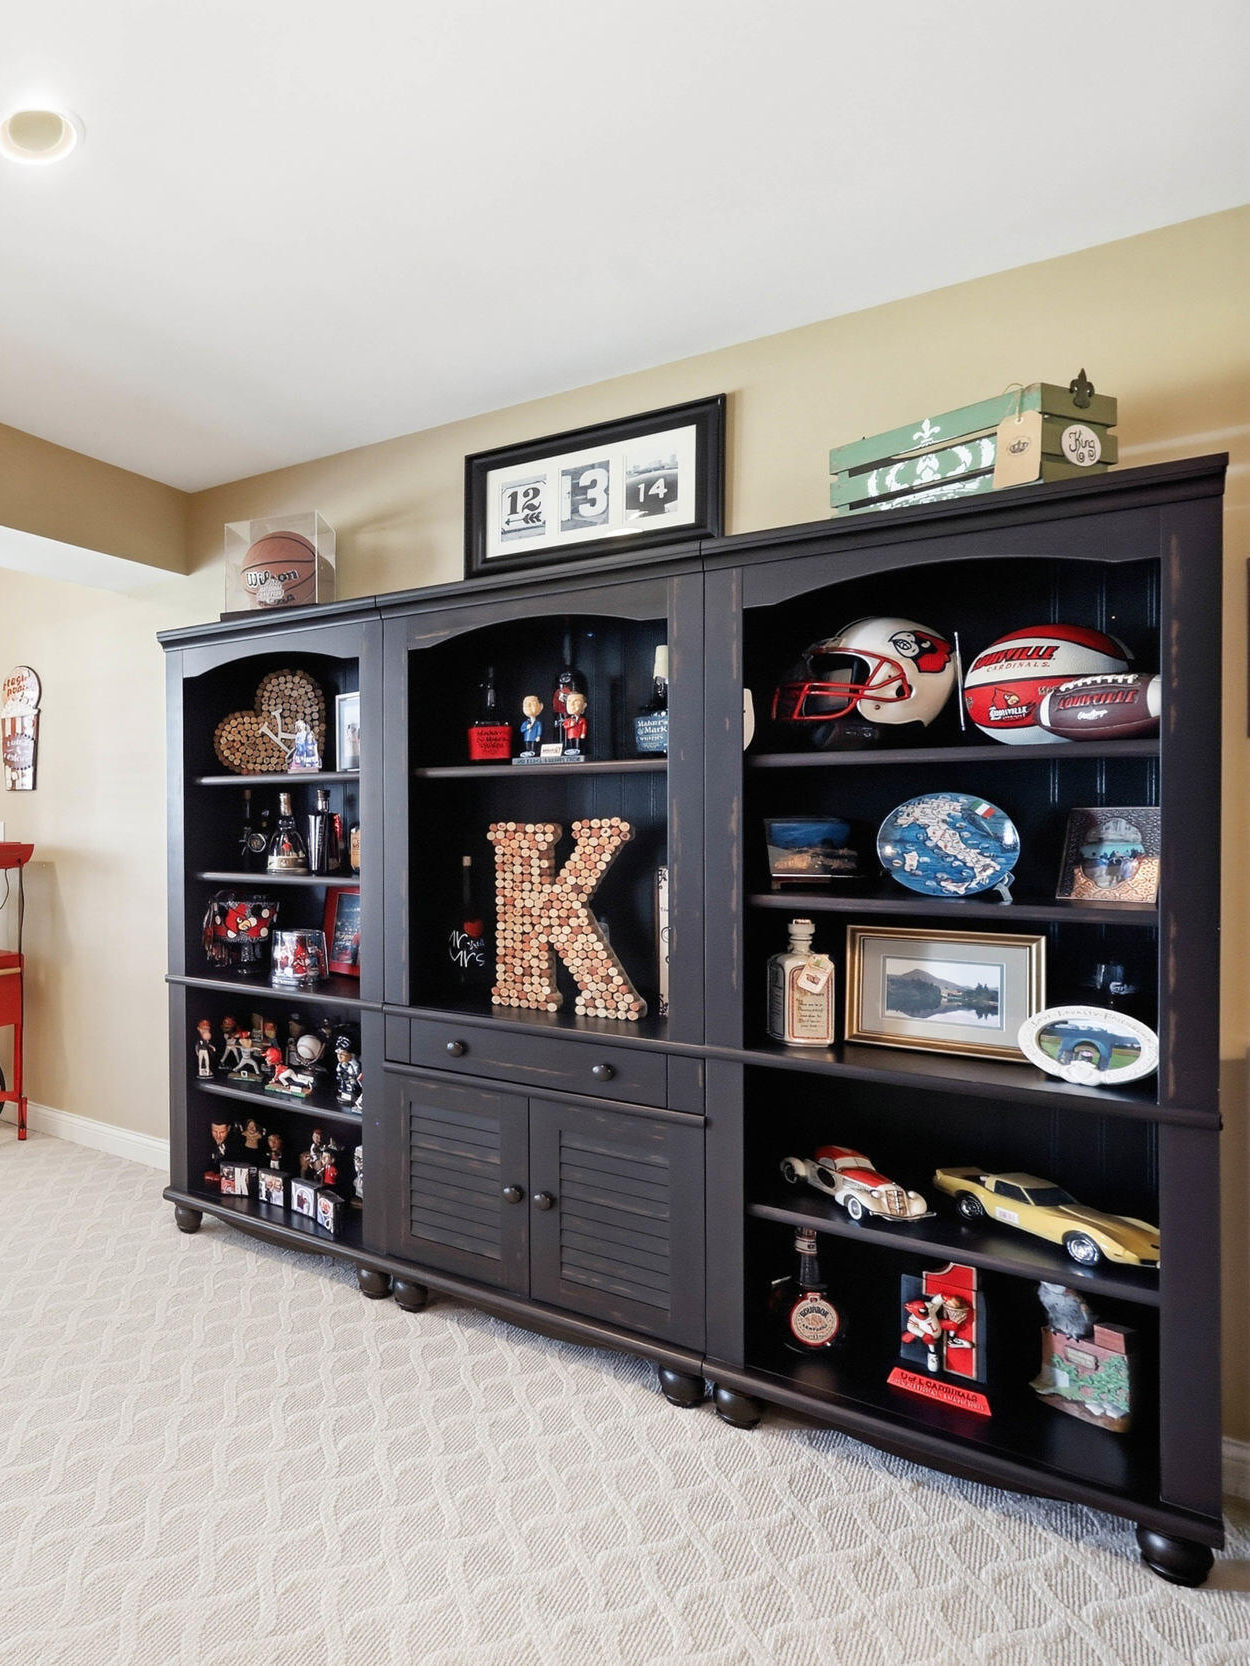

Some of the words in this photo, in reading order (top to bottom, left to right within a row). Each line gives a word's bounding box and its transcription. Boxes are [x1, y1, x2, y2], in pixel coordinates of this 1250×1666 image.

[507, 487, 541, 516] 12
[561, 468, 610, 522] 13
[638, 478, 667, 502] 14
[246, 569, 299, 588] Wilon
[487, 816, 640, 1021] K
